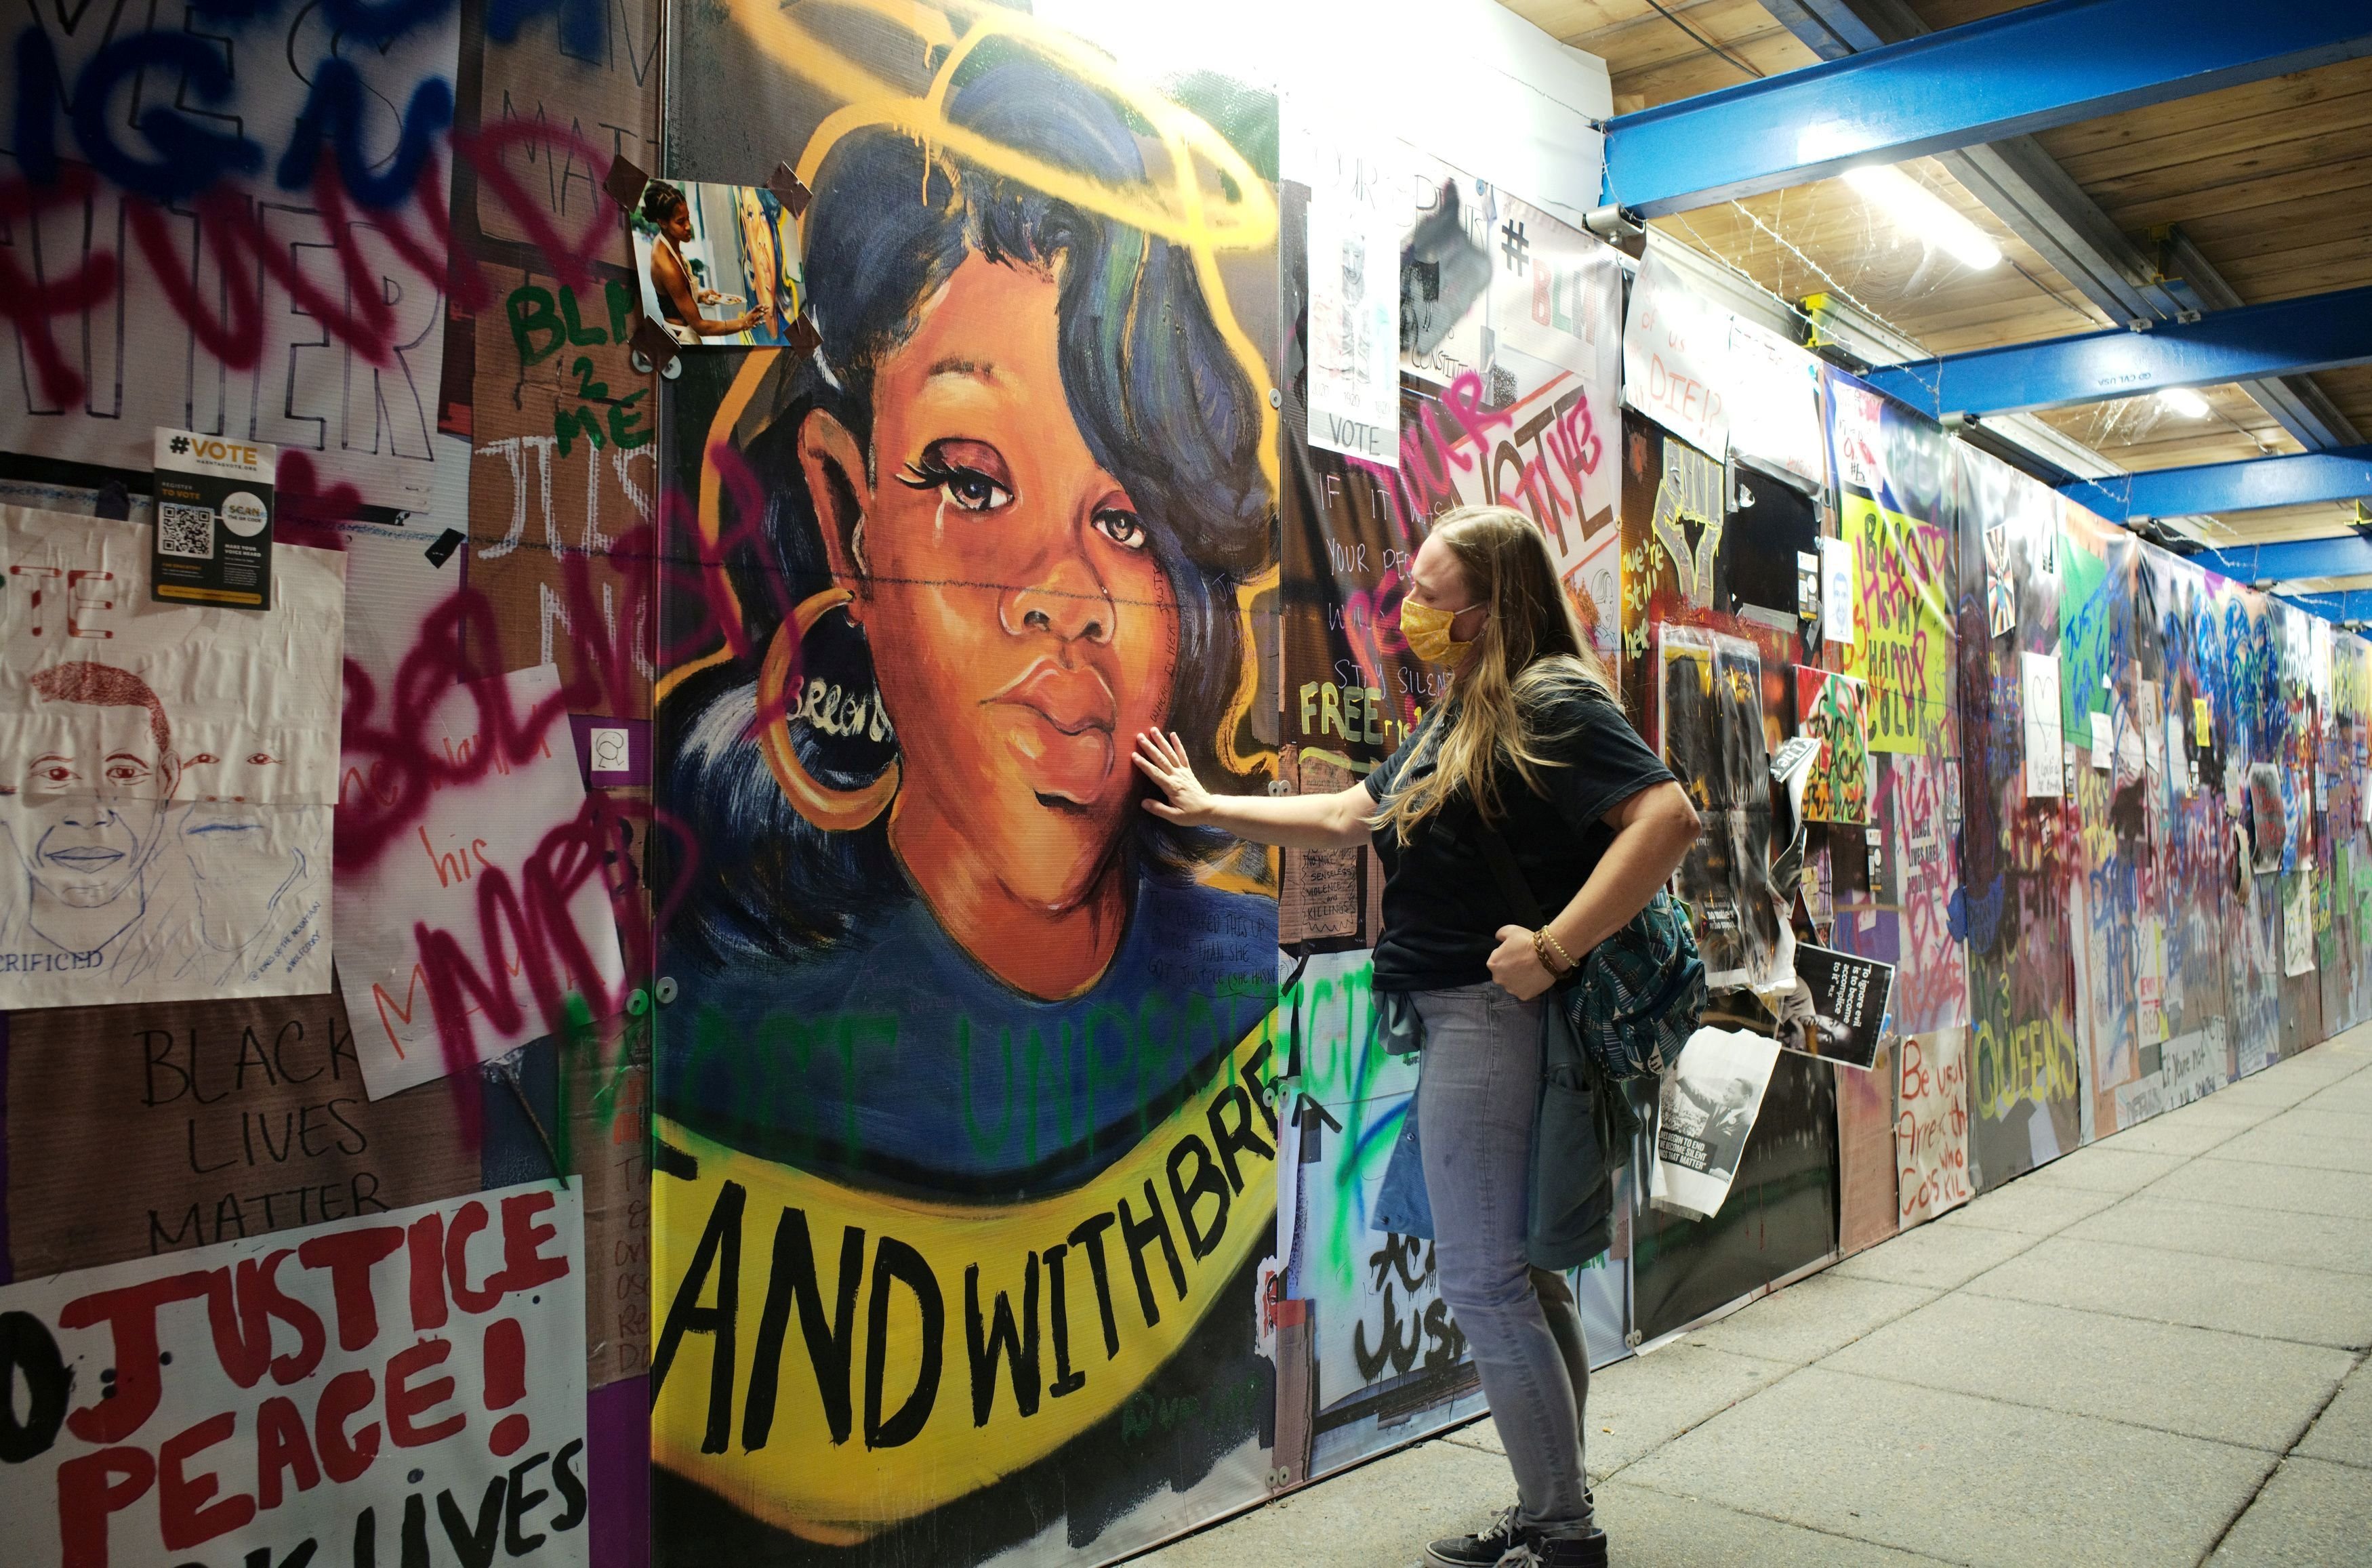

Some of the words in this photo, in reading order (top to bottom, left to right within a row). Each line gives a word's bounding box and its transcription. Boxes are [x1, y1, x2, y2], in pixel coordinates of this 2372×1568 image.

[1328, 412, 1381, 457] VOTE
[170, 436, 258, 466] #VOTE
[176, 489, 201, 500] VOTE
[1319, 473, 1341, 511] IF
[1371, 488, 1391, 520] IT
[229, 505, 260, 517] SCAN
[1326, 538, 1370, 577] YOUR
[1299, 681, 1385, 745] FREE
[1912, 819, 1931, 839] BLACK
[1908, 847, 1924, 867] LIVES
[1925, 844, 1936, 863] ARE
[1833, 962, 1841, 972] to
[1851, 976, 1858, 986] to
[1852, 966, 1861, 974] is
[1835, 964, 1849, 1014] accomplice
[1858, 979, 1869, 1009] ignore
[1843, 987, 1857, 1024] become
[1853, 1010, 1862, 1027] evil
[133, 1016, 359, 1107] BLACK
[1901, 1040, 1930, 1100] Be
[1973, 997, 2078, 1121] QUEENS
[188, 1098, 369, 1174] LIVES
[1668, 1132, 1683, 1143] BEGIN
[1684, 1137, 1692, 1147] TO
[1692, 1140, 1705, 1151] END
[1666, 1142, 1687, 1155] BECOME
[1685, 1147, 1707, 1161] SILENT
[1668, 1152, 1680, 1161] THAT
[148, 1172, 392, 1255] MATTER
[58, 1191, 570, 1445] JUSTICE
